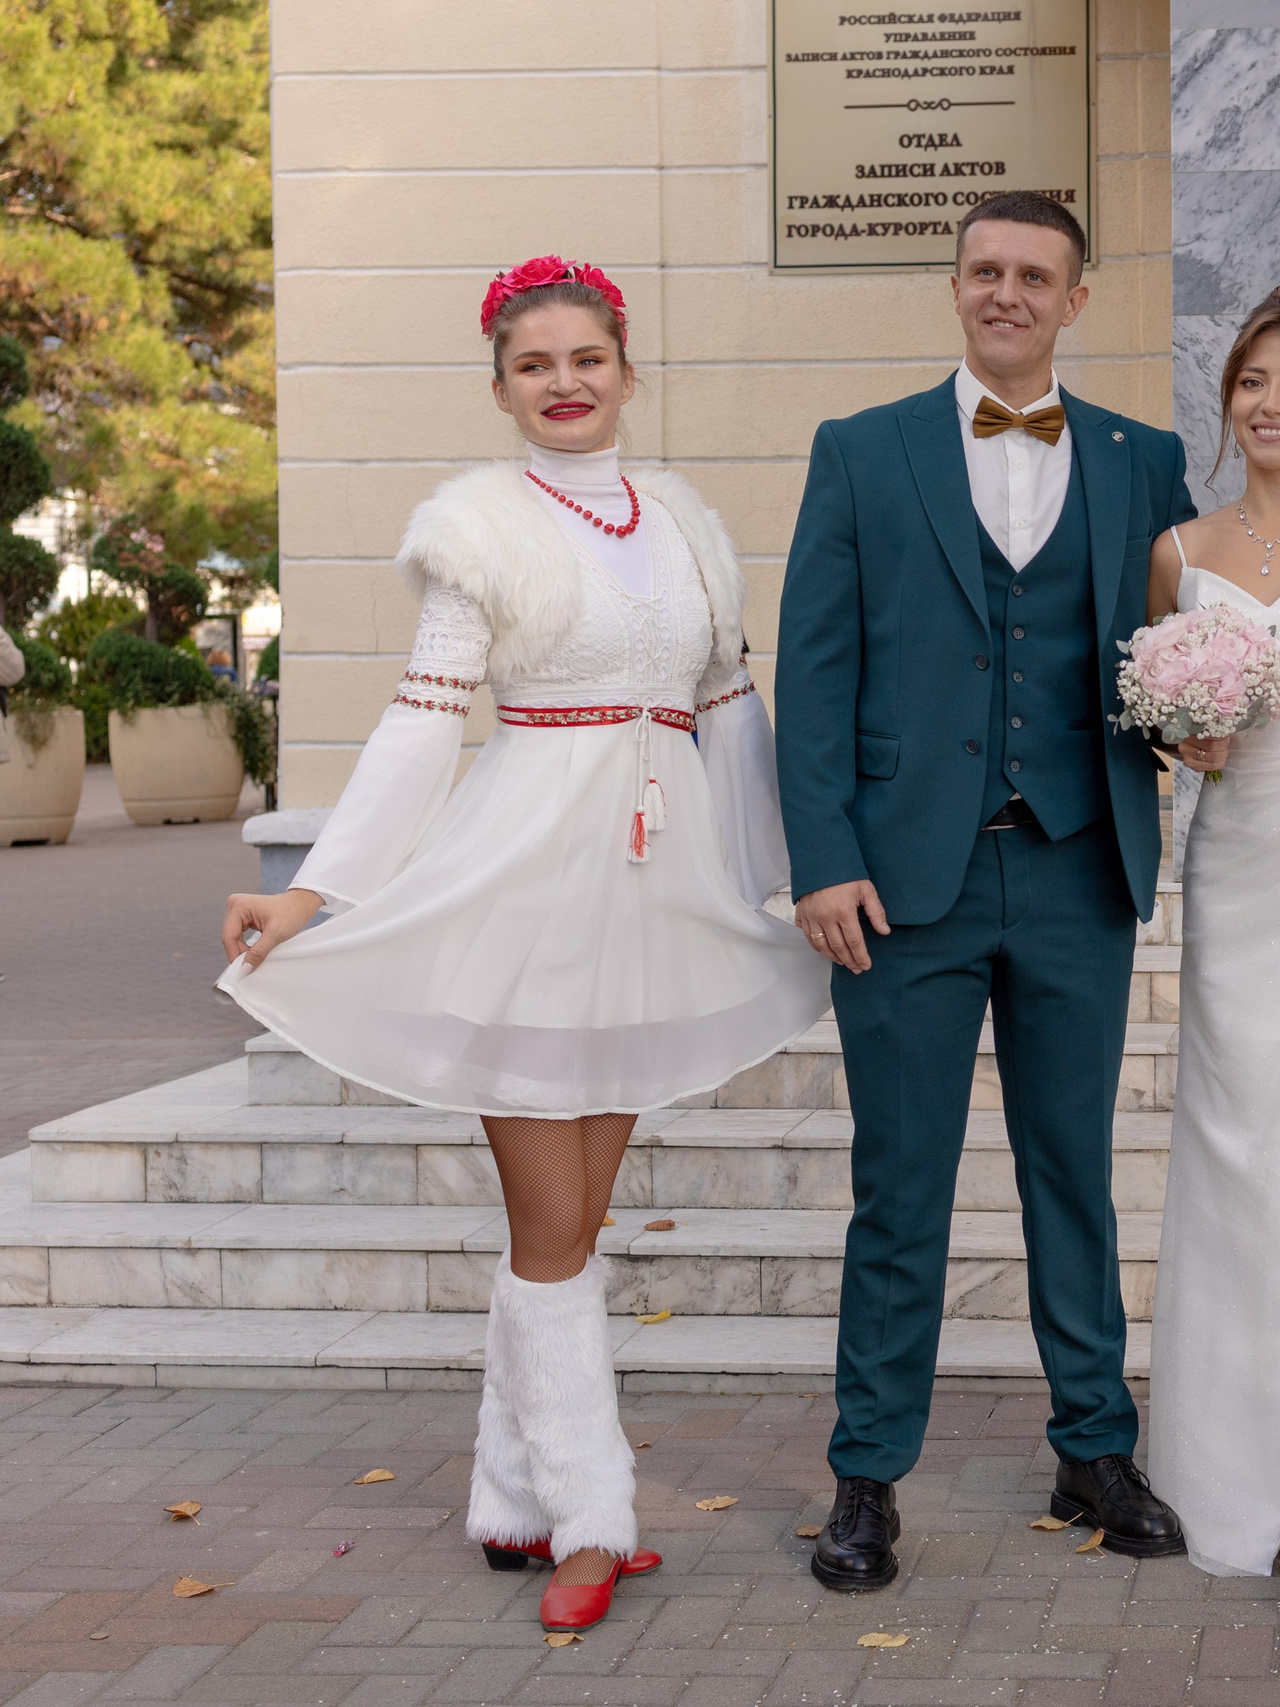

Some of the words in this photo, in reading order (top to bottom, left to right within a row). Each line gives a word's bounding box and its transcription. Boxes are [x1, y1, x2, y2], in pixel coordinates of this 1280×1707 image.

[838, 12, 935, 26] РОССИЙСКАЯ
[937, 11, 1021, 25] ФЕДЕРАЦИЯ
[883, 31, 976, 43] УПРАВЛЕНИЕ
[785, 52, 838, 63] ЗАПИСИ
[840, 51, 884, 61] АКТОВ
[886, 48, 992, 62] ГРАЖДАНСКОГО
[995, 46, 1076, 57] СОСТОЯНИЯ
[845, 66, 976, 80] КРАСНОДАРСКОГО
[979, 65, 1015, 76] КРАЯ
[898, 133, 962, 151] ОТДЕЛ
[855, 163, 936, 179] ЗАПИСИ
[939, 161, 1006, 177] АКТОВ
[787, 192, 948, 212] ГРАЖДАНСКОГО
[786, 221, 953, 241] ГОРОДА-КУРОРТА
